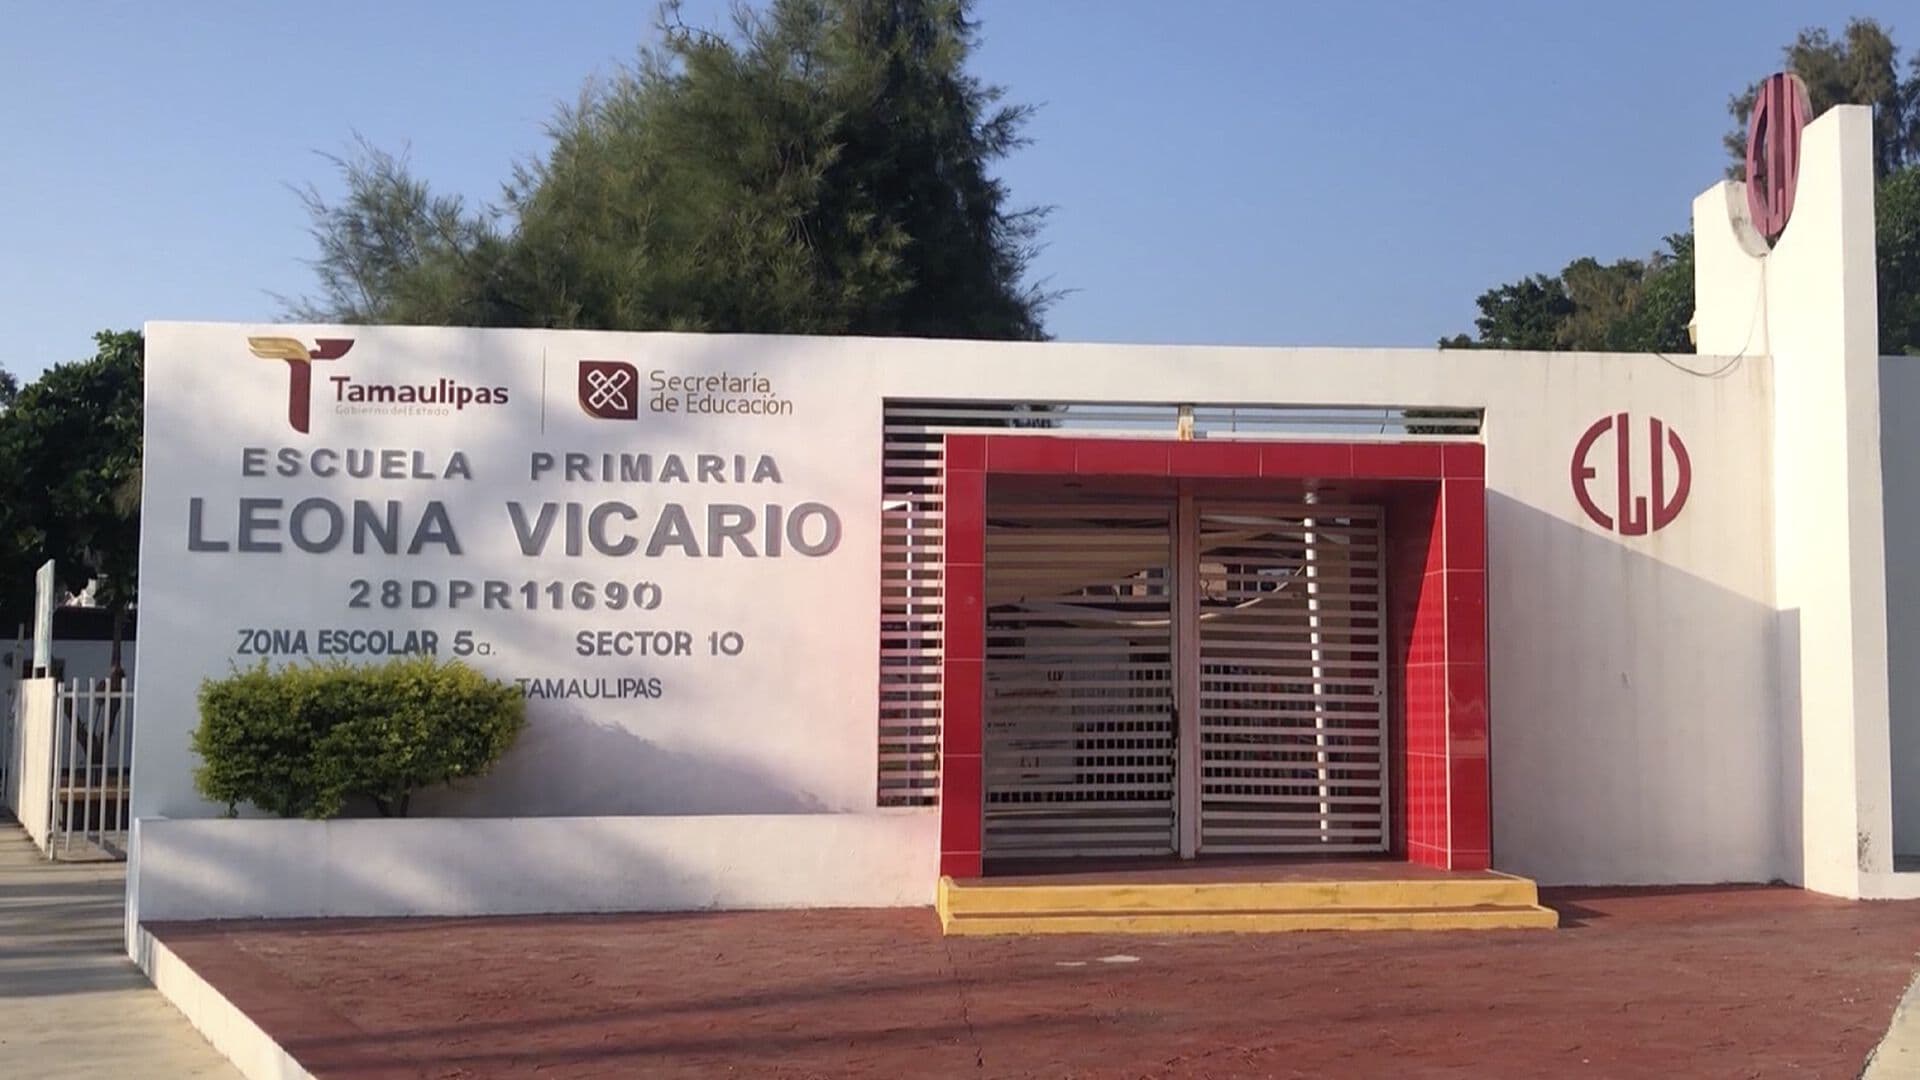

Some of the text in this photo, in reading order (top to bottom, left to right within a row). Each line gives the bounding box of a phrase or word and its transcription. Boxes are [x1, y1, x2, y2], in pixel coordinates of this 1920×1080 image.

[330, 376, 509, 410] Tamaulipas
[650, 370, 770, 393] Secretaría
[335, 404, 389, 416] Gobierno
[650, 392, 793, 415] de Educación
[243, 447, 783, 483] ESCUELA PRIMARIA
[188, 496, 842, 557] LEONA VICARIO
[349, 579, 663, 610] 28DPR11690
[237, 629, 309, 655] ZONA
[317, 630, 438, 655] ESCOLAR
[576, 630, 693, 656] SECTOR
[708, 631, 744, 656] 10
[516, 678, 663, 698] TAMAULIPAS
